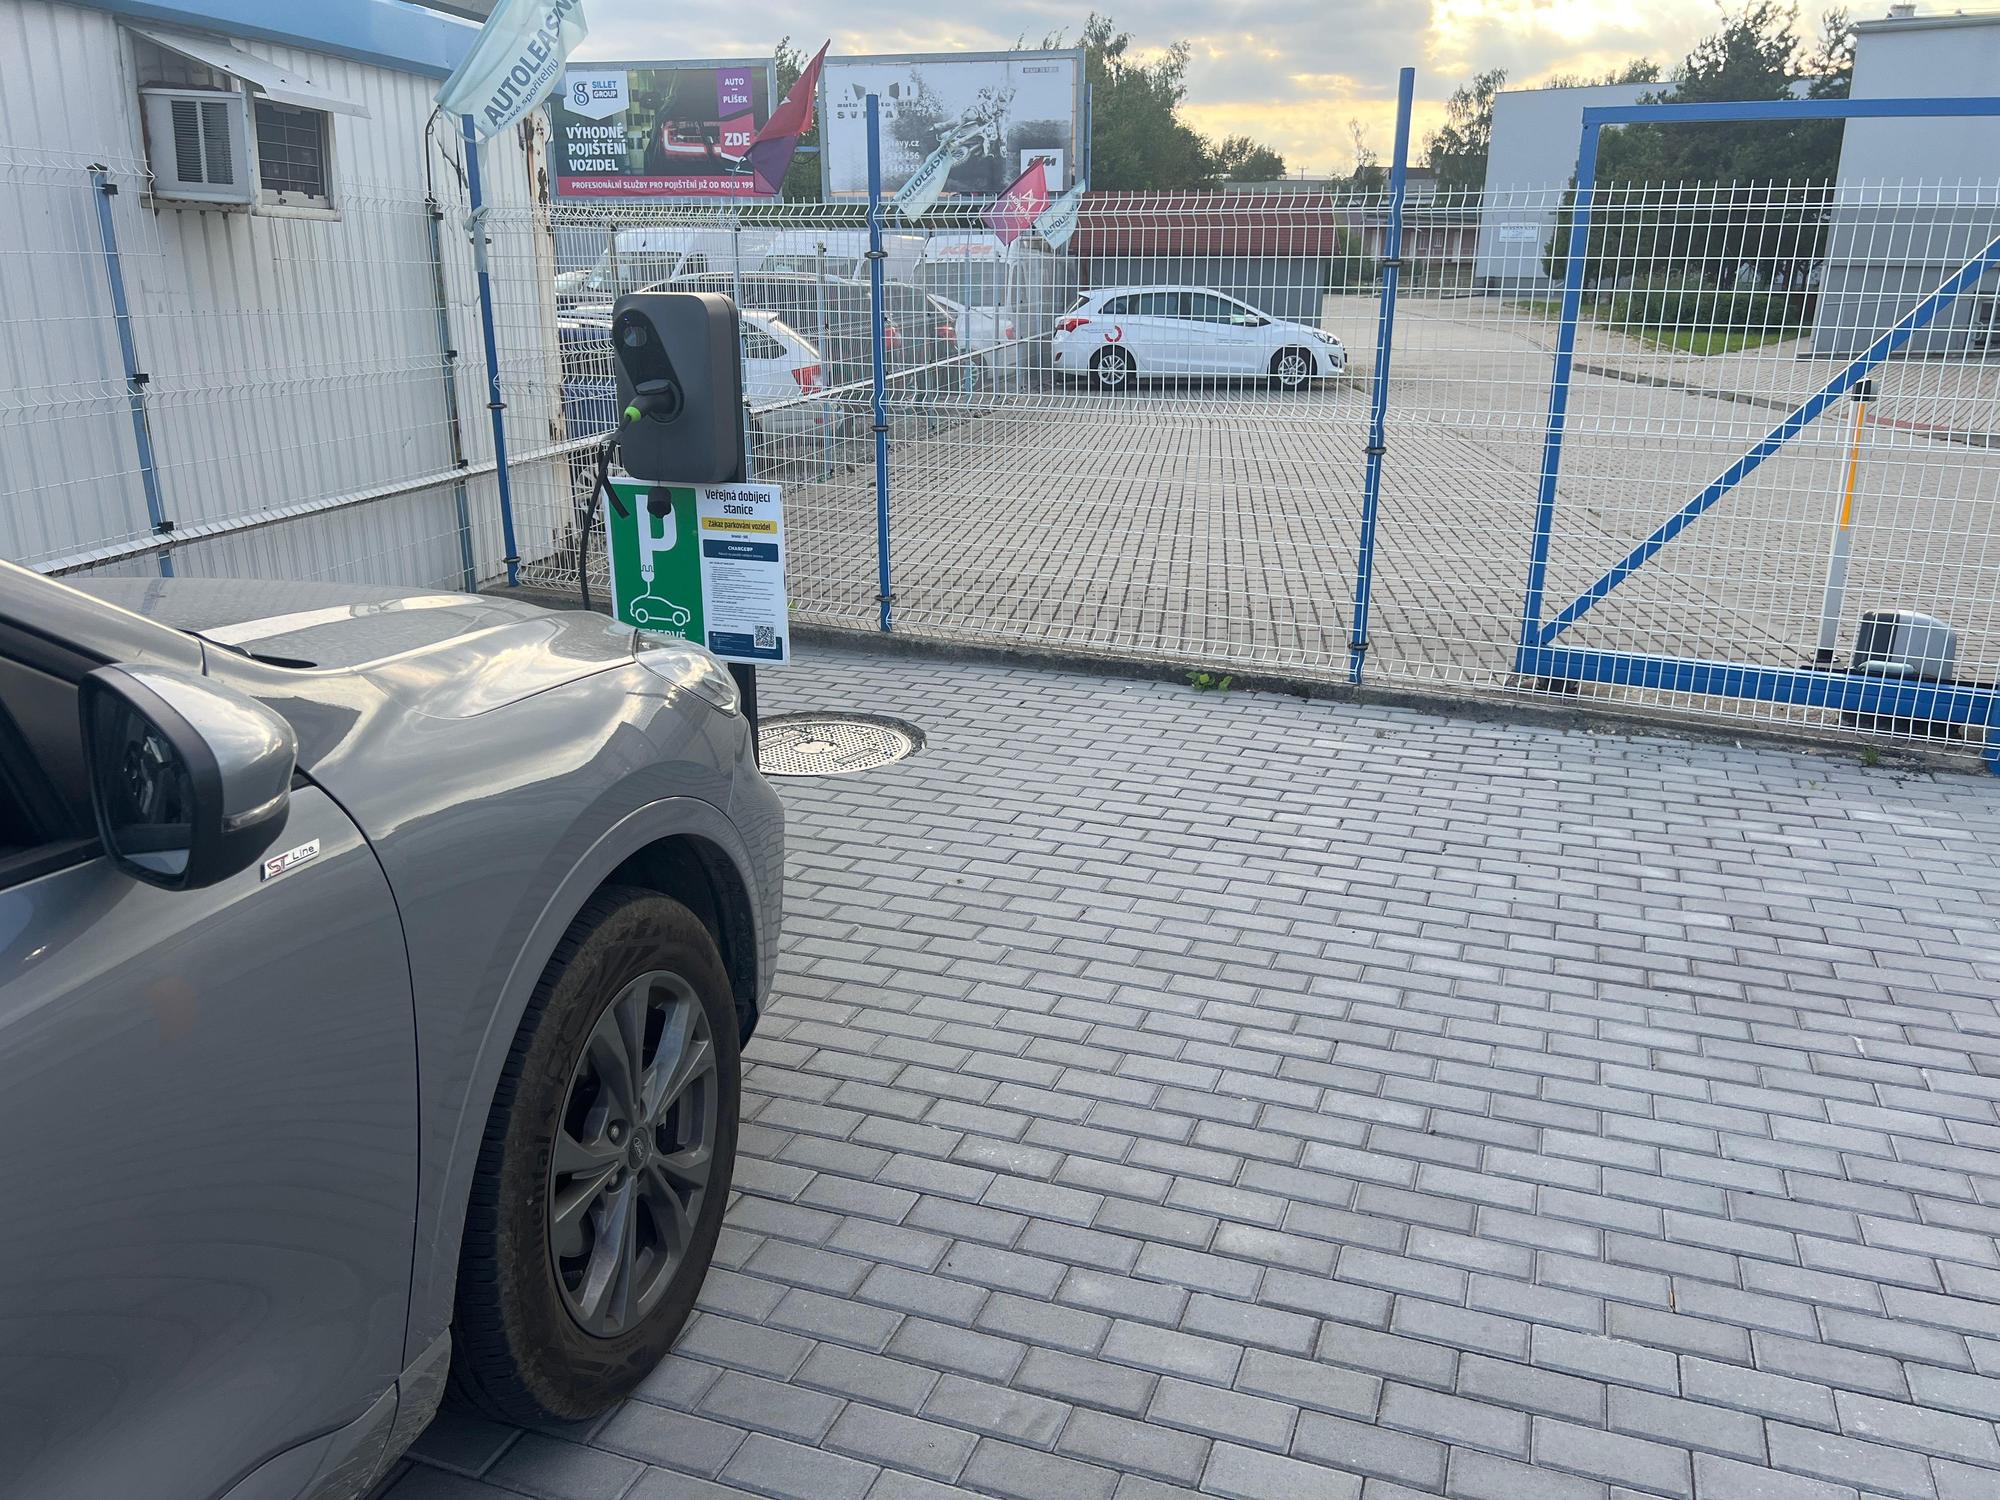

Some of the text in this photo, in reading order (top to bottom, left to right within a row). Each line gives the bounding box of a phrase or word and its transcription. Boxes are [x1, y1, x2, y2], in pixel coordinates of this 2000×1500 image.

[592, 81, 617, 89] SILLET
[724, 78, 745, 86] AUTO
[593, 90, 617, 98] GROUP
[566, 122, 625, 139] VÝHODNÉ
[724, 132, 751, 146] ZDE
[568, 139, 627, 158] POJIŠTĚNÍ
[569, 159, 619, 171] VOZIDEL
[623, 180, 647, 189] SLUŽBY
[649, 181, 663, 189] PRO
[708, 181, 719, 189] OD
[705, 488, 736, 502] Veřejná
[723, 503, 754, 515] stanice
[751, 523, 771, 531] vozidel
[267, 845, 315, 877] ST Line
